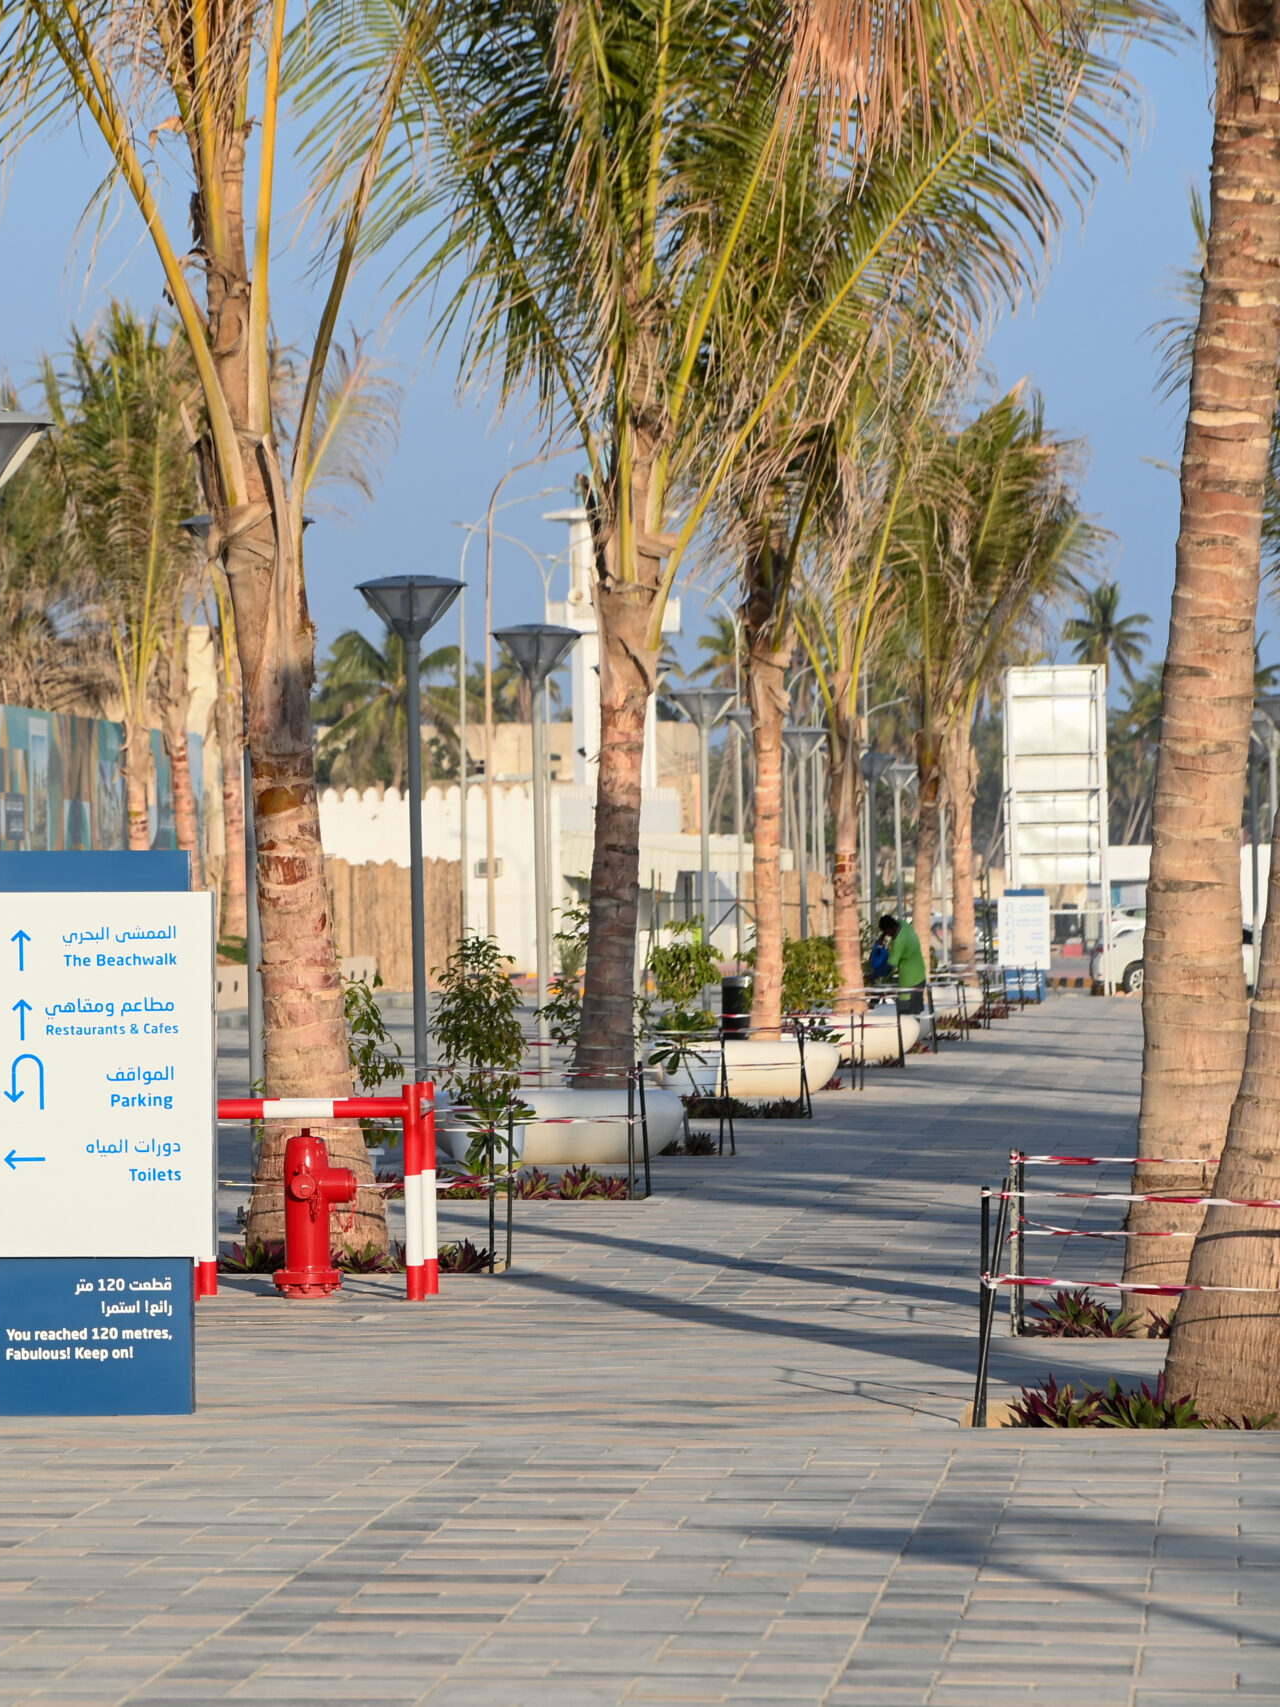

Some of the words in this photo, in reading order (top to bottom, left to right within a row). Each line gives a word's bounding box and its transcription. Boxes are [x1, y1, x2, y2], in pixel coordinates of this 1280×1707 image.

[61, 925, 110, 947] البحري
[114, 924, 177, 944] الممشى
[63, 953, 92, 968] The
[95, 952, 178, 967] Beachwalk
[44, 997, 116, 1020] ومقاهي
[120, 996, 175, 1018] مطاعم
[45, 1024, 127, 1036] Restaurants
[129, 1023, 140, 1035] &
[143, 1022, 180, 1035] Cafes
[105, 1065, 175, 1086] المواقف
[110, 1092, 174, 1110] Parking
[85, 1138, 129, 1158] المياه
[134, 1137, 182, 1158] دورات
[128, 1167, 183, 1182] Toilets
[74, 1278, 94, 1296] متر
[97, 1277, 126, 1292] 120
[128, 1276, 173, 1292] قطعت
[5, 1328, 32, 1342] You
[34, 1327, 88, 1341] reached
[91, 1326, 119, 1340] 120
[5, 1346, 71, 1361] Fabulous!
[74, 1346, 109, 1362] Keep
[111, 1345, 134, 1360] on!
